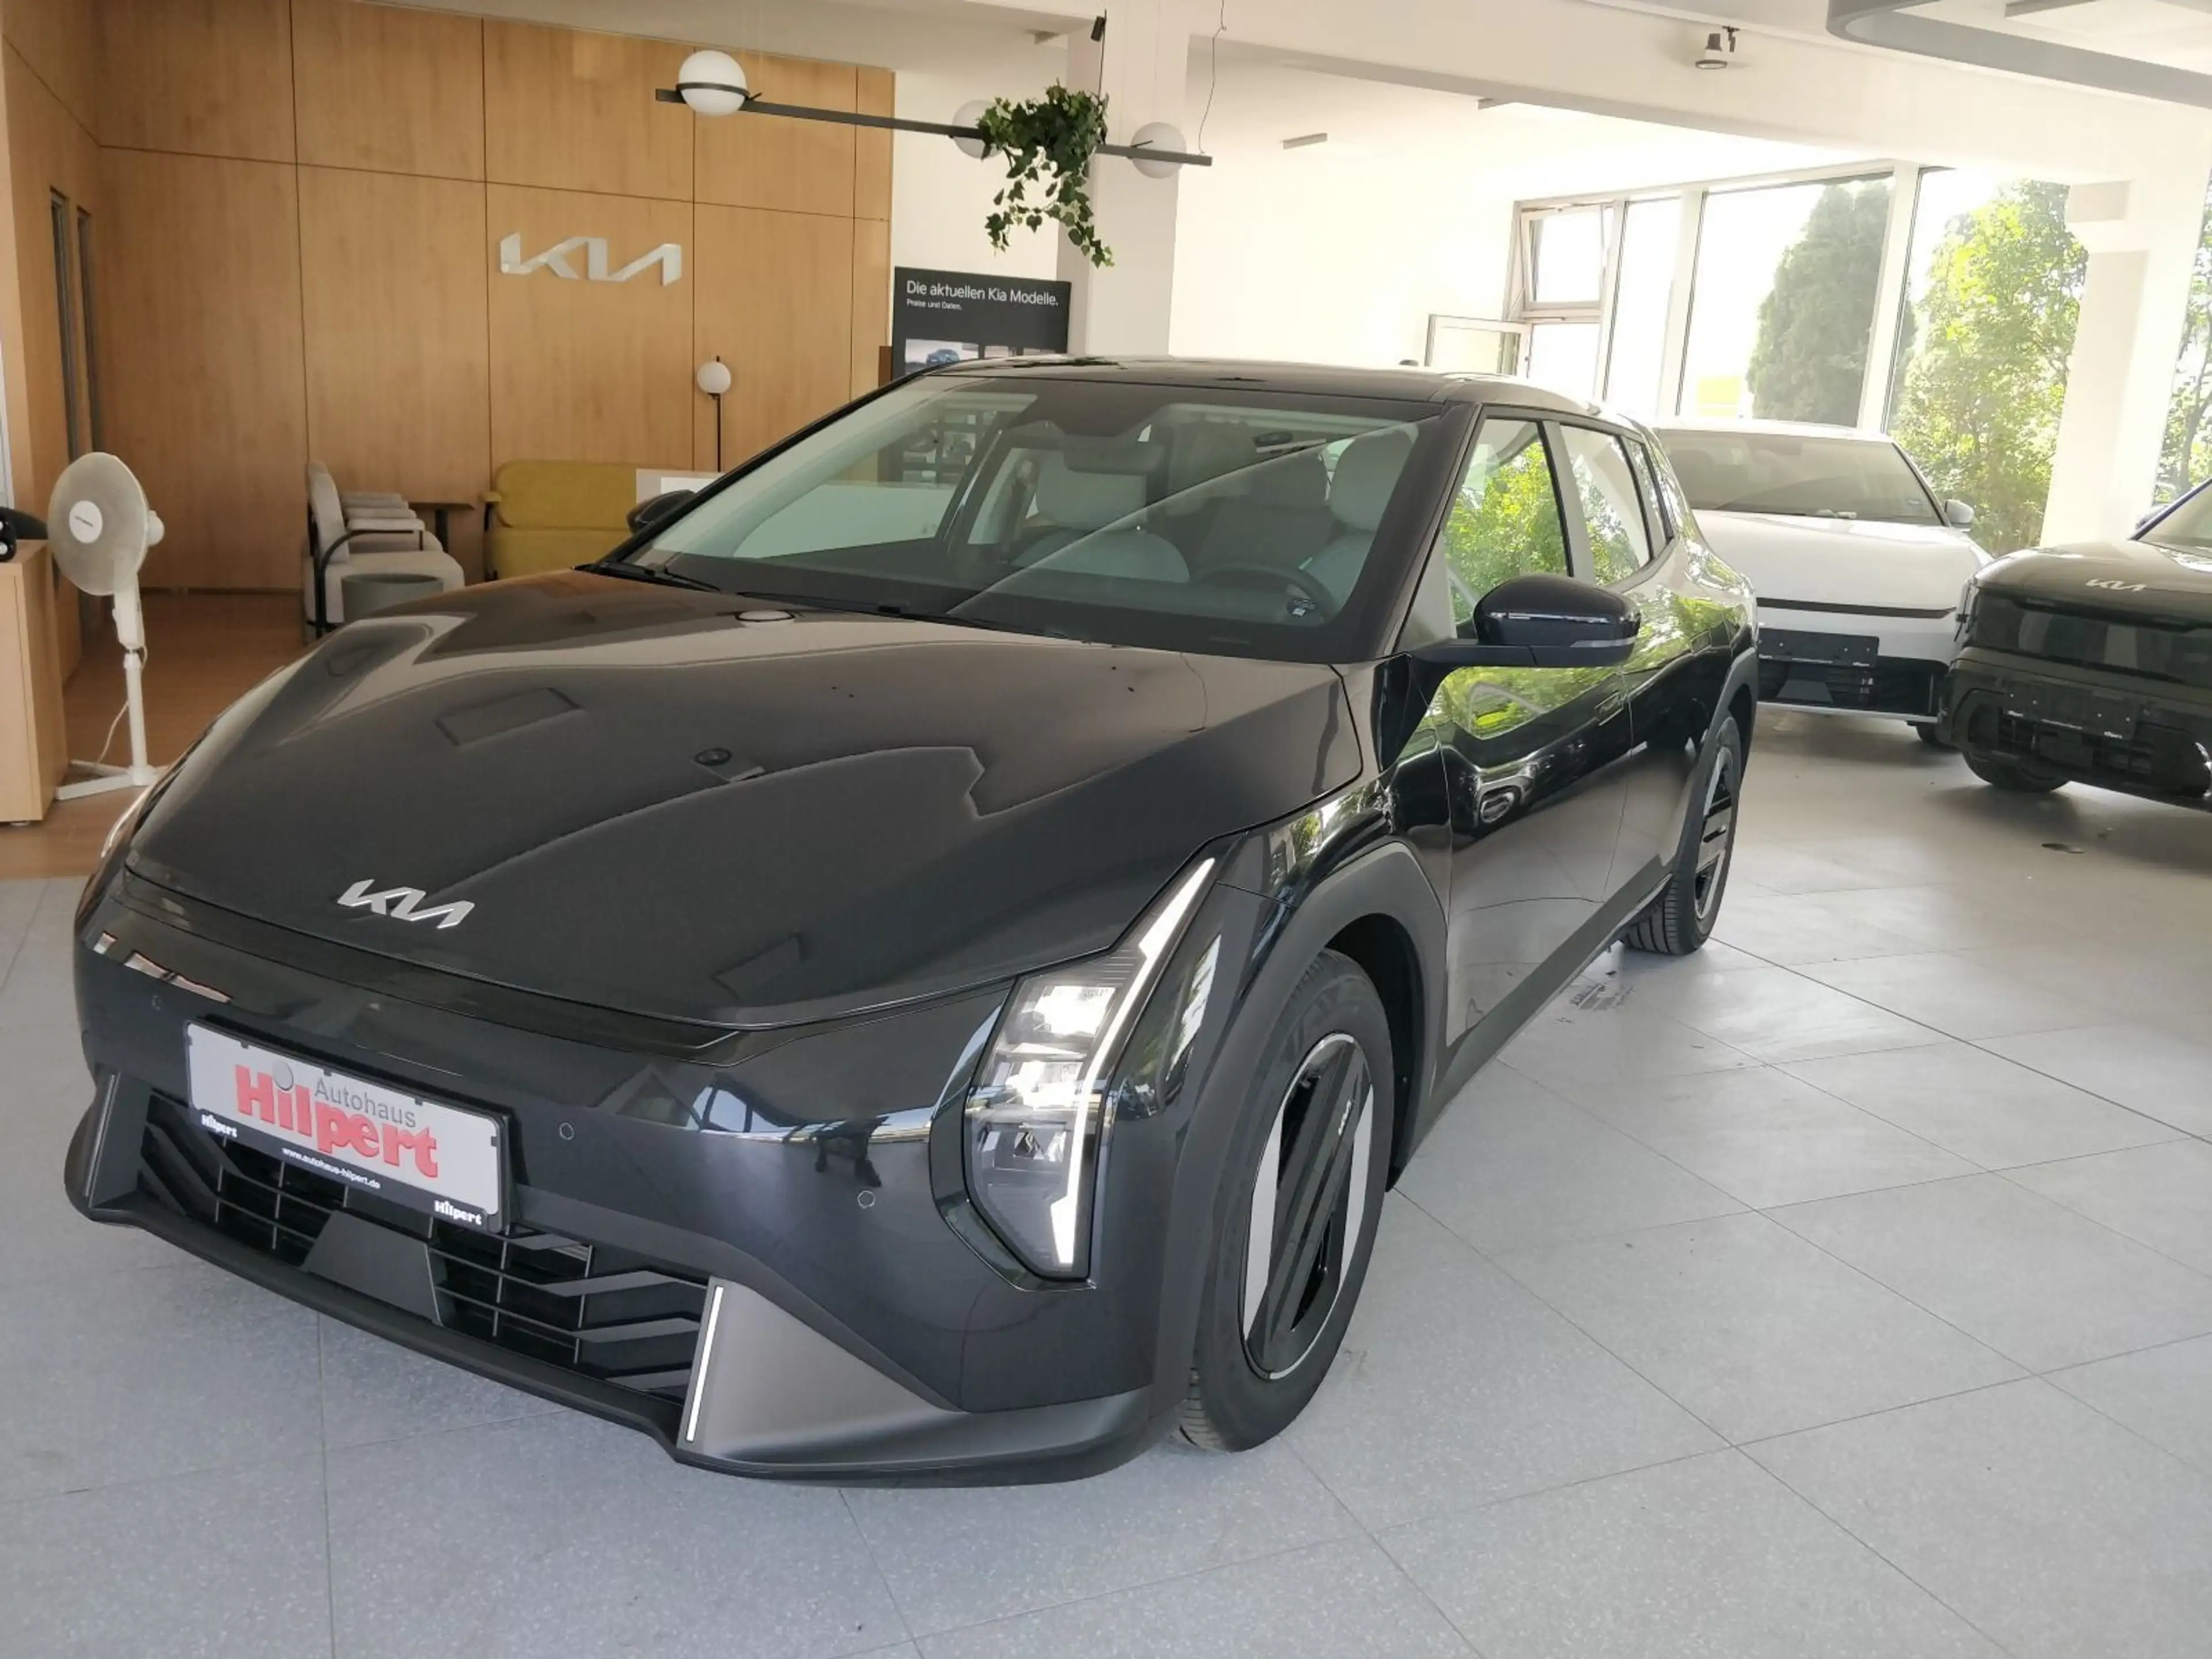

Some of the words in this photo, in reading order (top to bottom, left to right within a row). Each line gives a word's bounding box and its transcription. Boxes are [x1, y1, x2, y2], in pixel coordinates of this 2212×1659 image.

[500, 232, 681, 287] KIA
[907, 280, 927, 295] Die
[930, 282, 985, 300] aktuellen
[988, 287, 1007, 301] Kia
[1010, 290, 1059, 306] Modelle.
[2085, 578, 2147, 592] KIA
[337, 879, 475, 929] KIA
[235, 1061, 438, 1178] Hilpert
[315, 1077, 416, 1128] Autohaus
[201, 1113, 237, 1138] Hilpert
[282, 1147, 381, 1190] www.autohaus-hilpert.de
[434, 1200, 482, 1226] Hilpert
